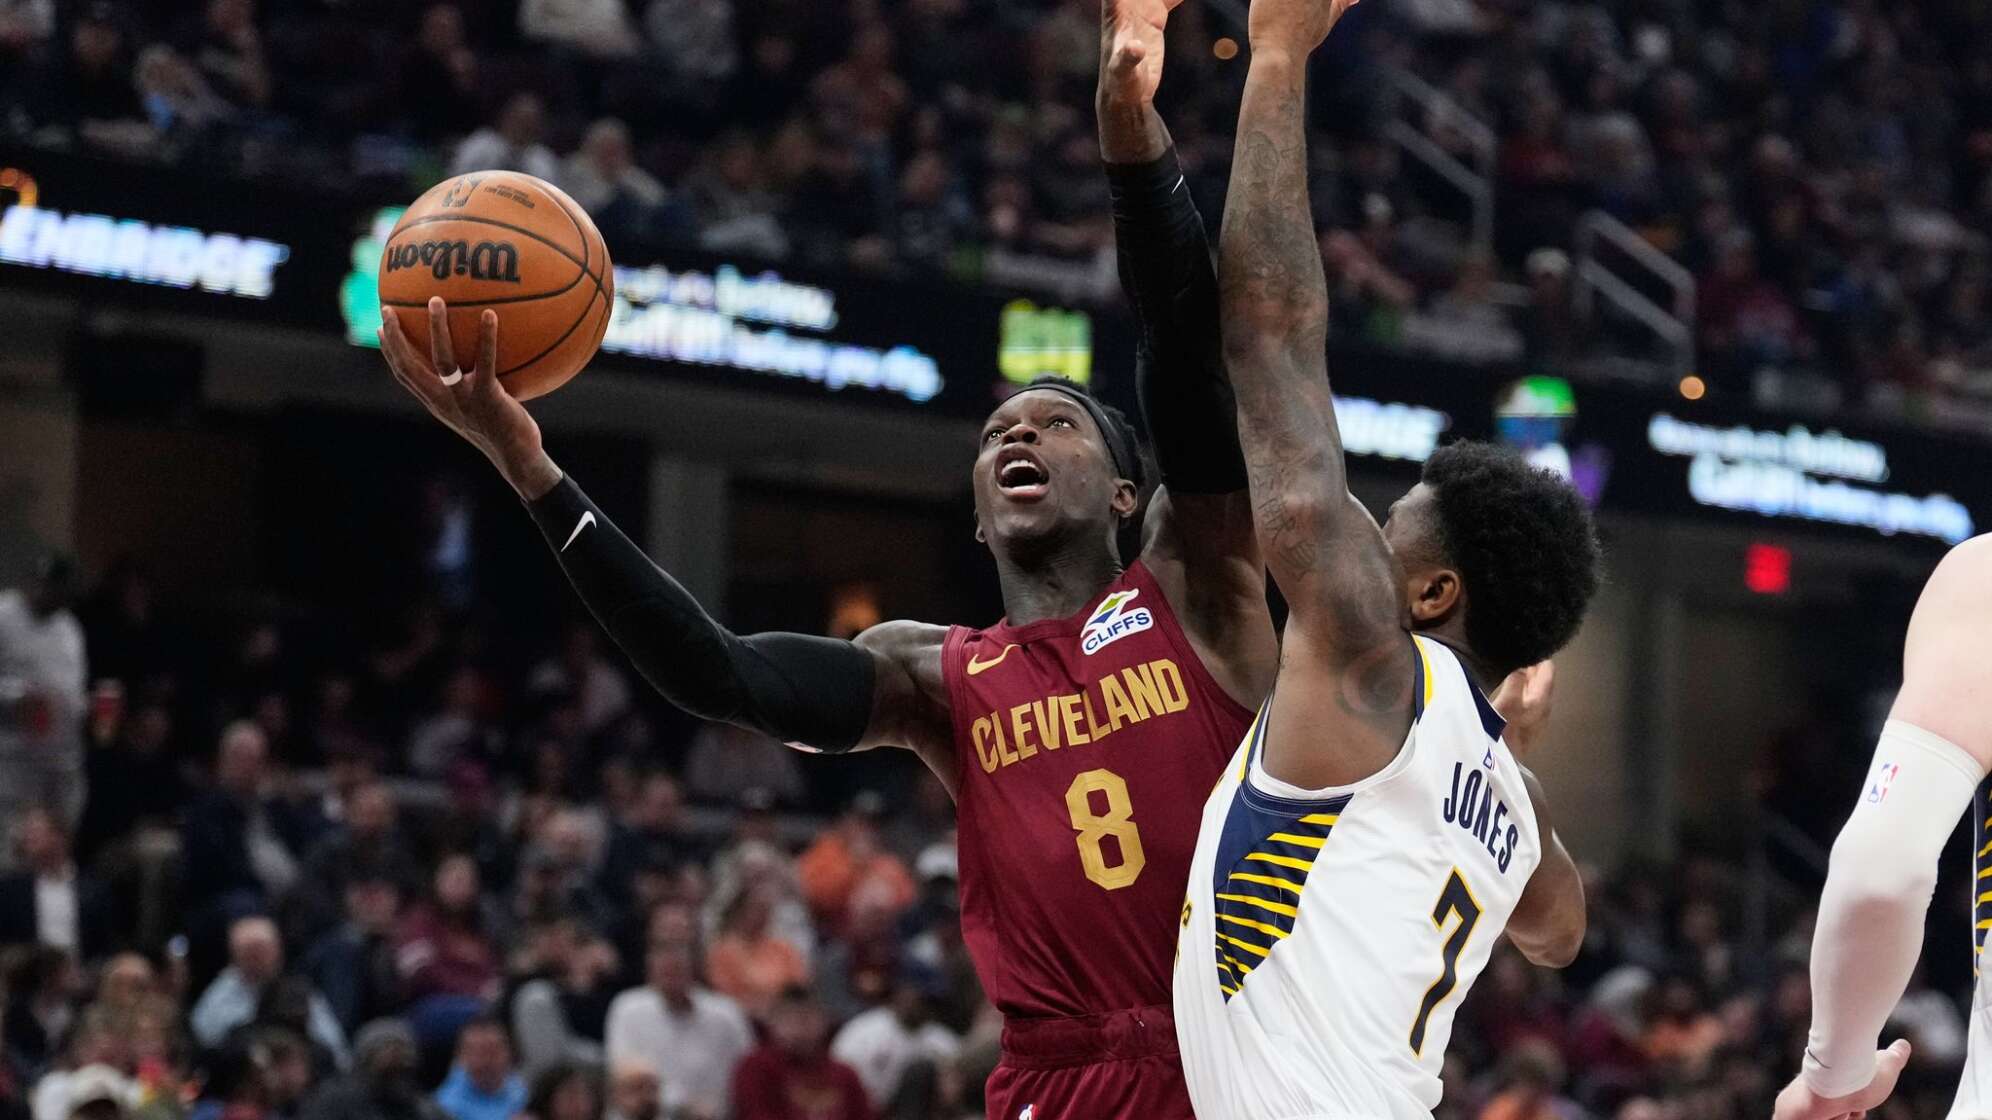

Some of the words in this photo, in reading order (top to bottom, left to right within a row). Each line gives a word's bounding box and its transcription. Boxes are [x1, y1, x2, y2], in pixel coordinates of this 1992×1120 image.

[387, 239, 521, 284] Wilson
[1085, 612, 1151, 652] CLIFFS
[971, 658, 1190, 774] CLEVELAND
[1064, 767, 1146, 891] 8
[1443, 761, 1519, 874] JONES
[1408, 865, 1485, 1059] 7
